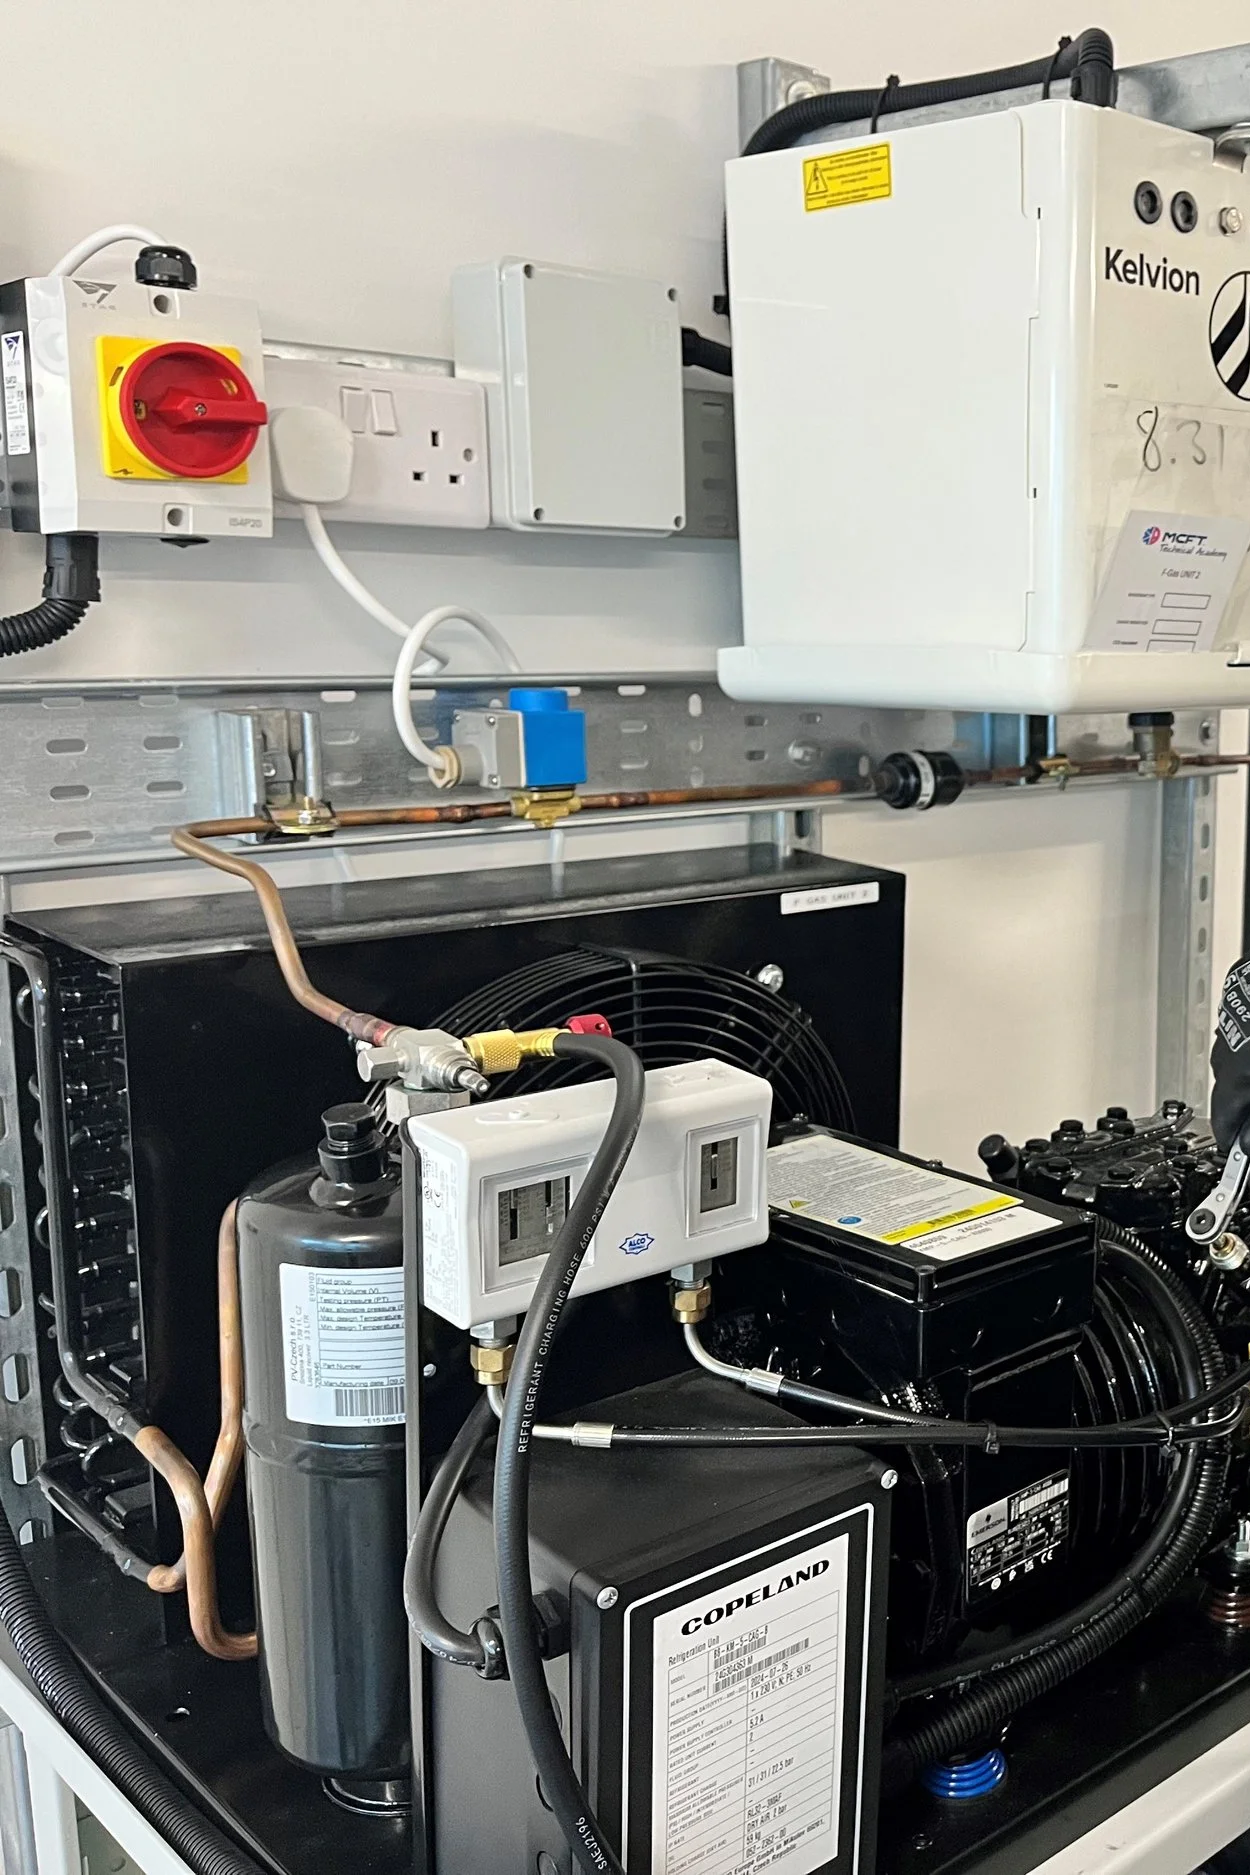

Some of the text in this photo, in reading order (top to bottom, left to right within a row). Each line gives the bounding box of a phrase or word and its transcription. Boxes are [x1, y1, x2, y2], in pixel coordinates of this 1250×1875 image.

[1105, 246, 1200, 296] Kelvion
[1160, 544, 1228, 562] Technical Academy
[1162, 532, 1208, 546] MCFT
[628, 1237, 646, 1248] ALCO
[518, 1361, 544, 1453] REFRIGERANT
[539, 1290, 567, 1355] CHARGING
[563, 1253, 581, 1285] HOSE
[580, 1226, 593, 1249] 600
[681, 1559, 830, 1635] COPELAND
[669, 1635, 720, 1667] Refrigeration Unit
[760, 1682, 770, 1696] 230
[795, 1665, 803, 1678] 50
[749, 1712, 763, 1729] 5.2 A
[784, 1754, 794, 1768] bar
[575, 1816, 608, 1870] SAEJ2196
